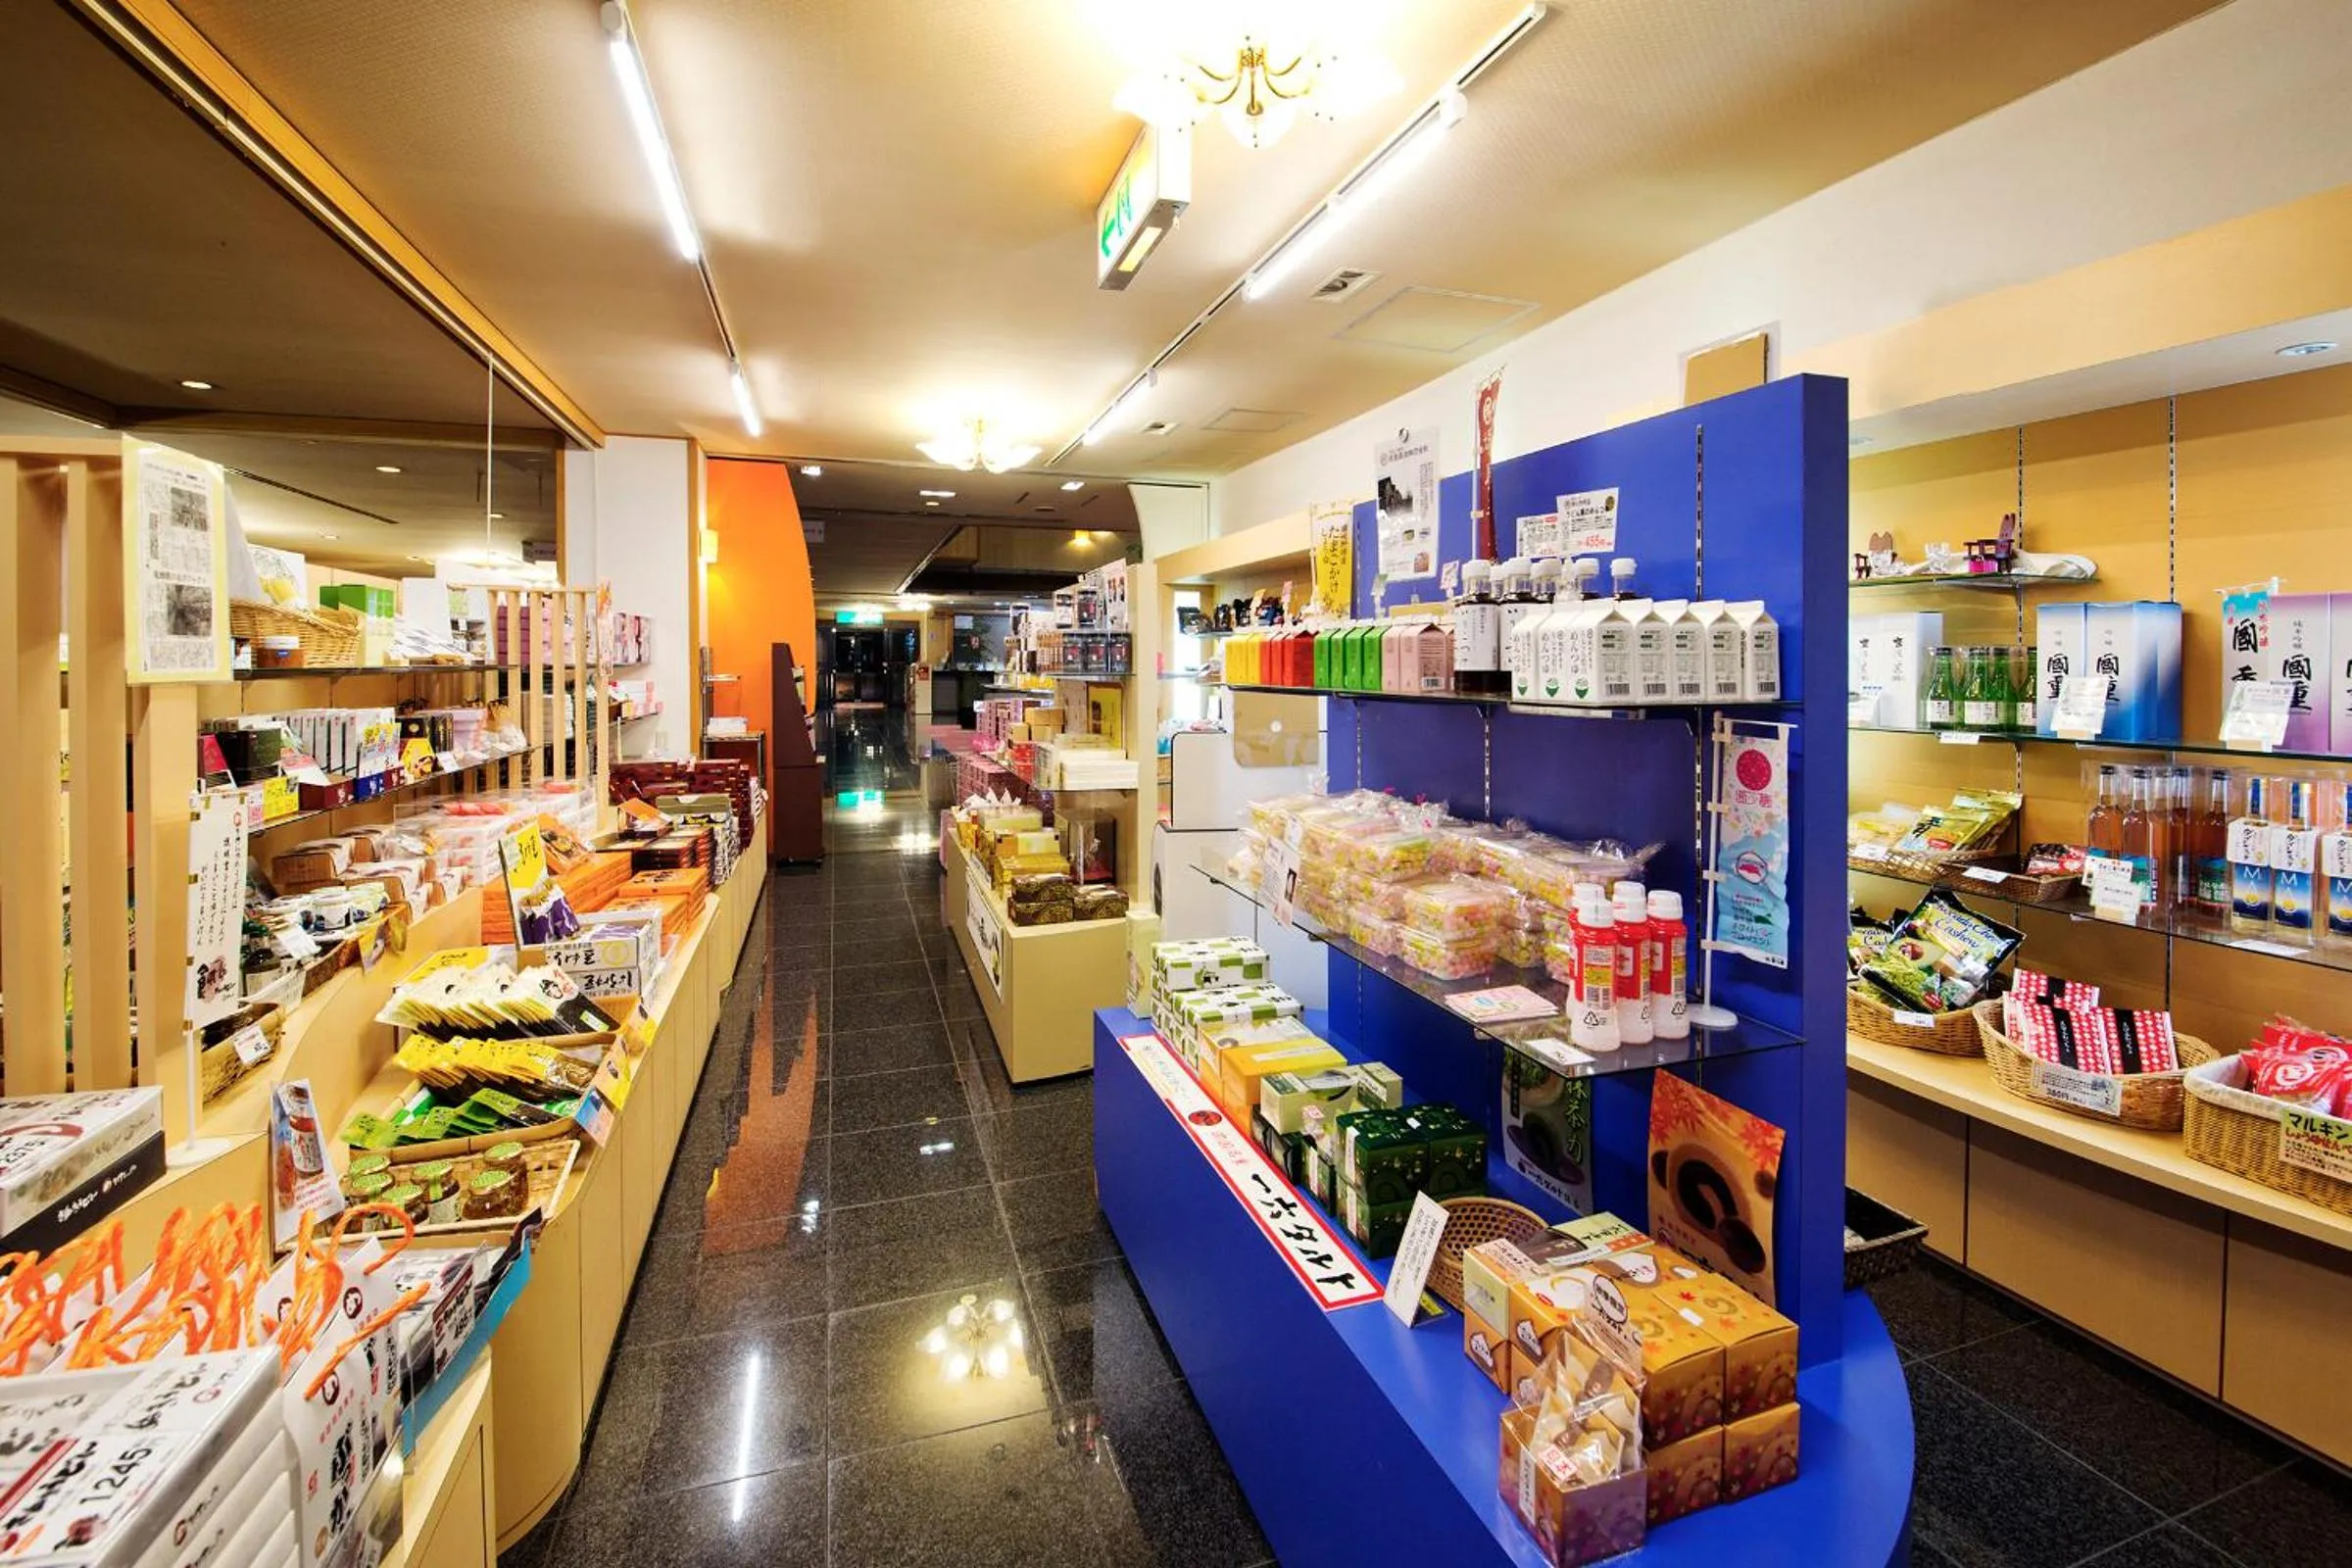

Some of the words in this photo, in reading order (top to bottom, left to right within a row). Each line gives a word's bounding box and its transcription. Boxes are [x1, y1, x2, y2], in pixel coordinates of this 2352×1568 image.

[2288, 1112, 2350, 1140] マルキン
[1251, 1173, 1356, 1291] 一六タルト
[79, 1446, 153, 1506] 1245
